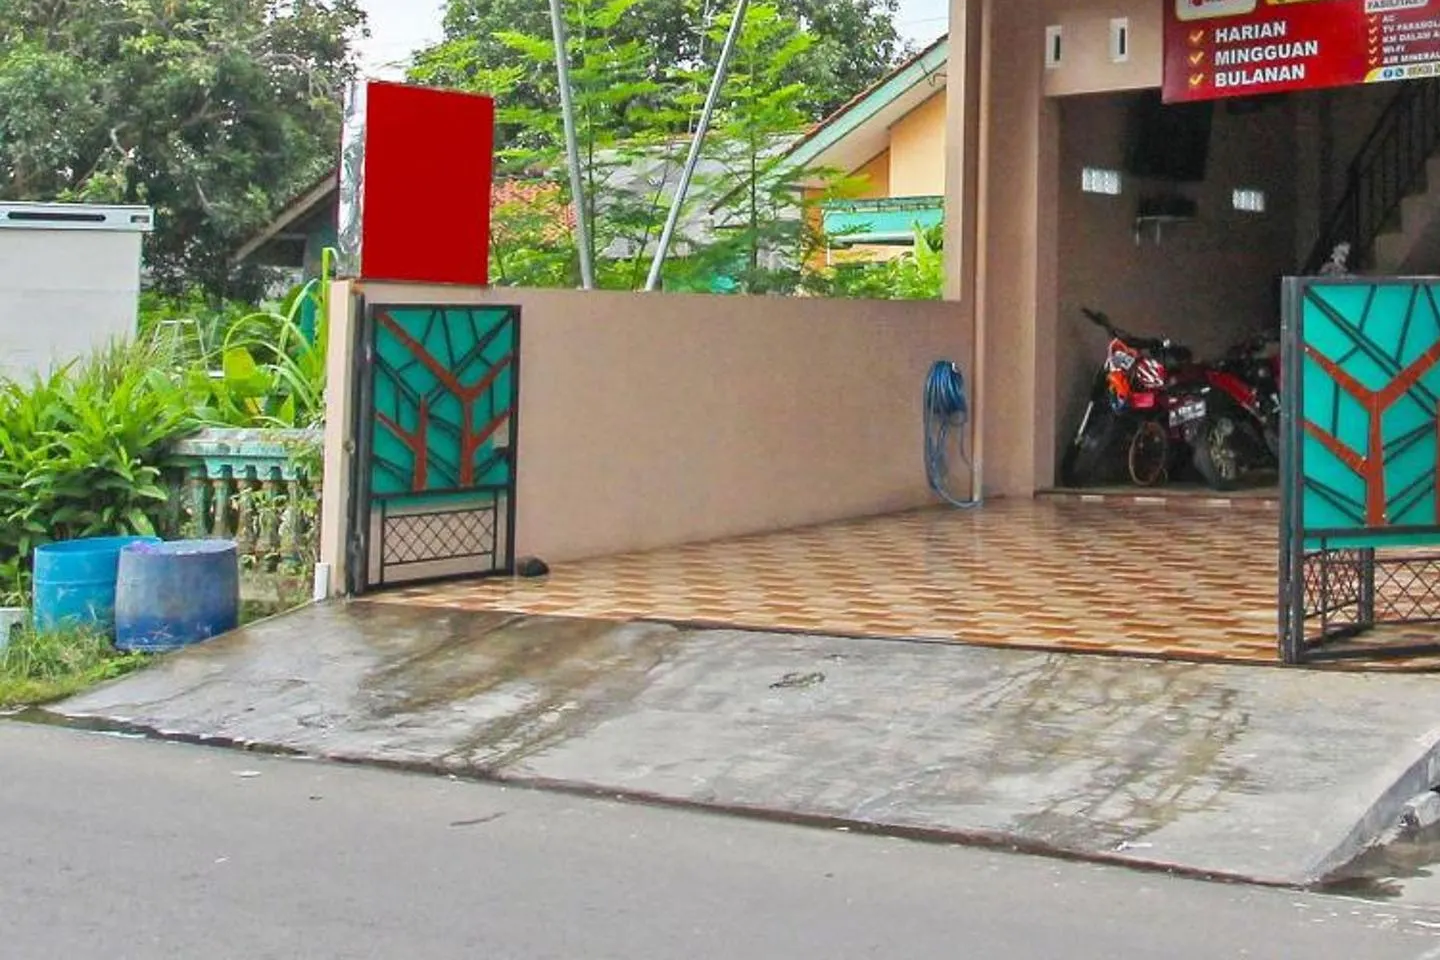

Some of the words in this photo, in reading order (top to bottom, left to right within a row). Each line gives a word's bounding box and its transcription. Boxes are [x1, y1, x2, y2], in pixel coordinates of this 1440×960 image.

[1215, 21, 1287, 43] HARIAN
[1383, 25, 1395, 33] TV
[1215, 40, 1319, 66] MINGGUAN
[1383, 56, 1398, 64] AIR
[1215, 64, 1305, 87] BULANAN
